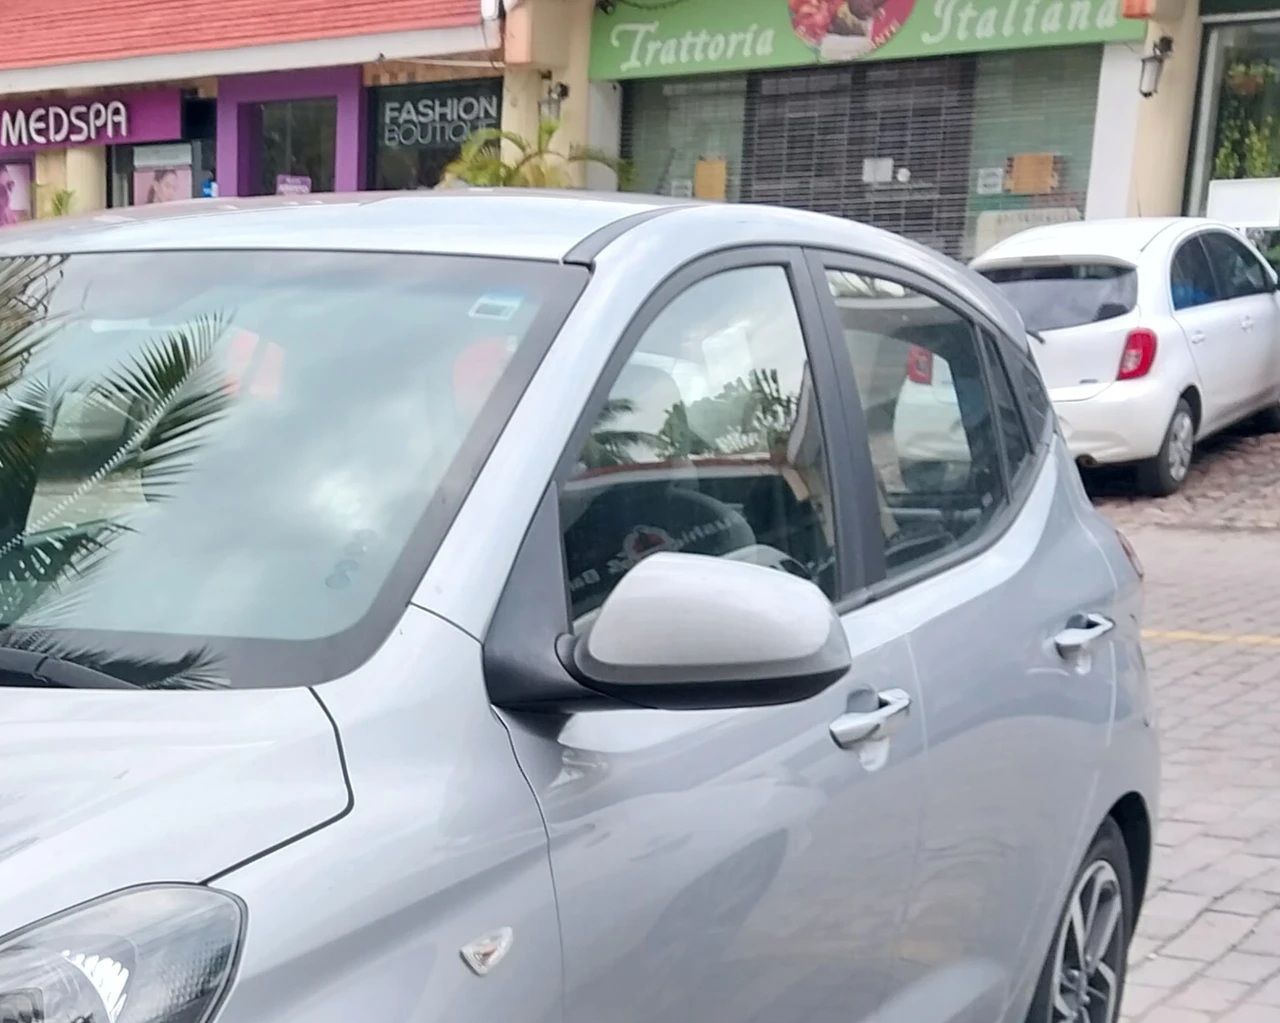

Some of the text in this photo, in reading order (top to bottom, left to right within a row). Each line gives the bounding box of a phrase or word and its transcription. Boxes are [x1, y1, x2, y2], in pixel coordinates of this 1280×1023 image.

[610, 20, 775, 71] Trattoria
[921, 0, 1118, 44] Italiana
[1, 100, 127, 147] MEDSPA
[384, 95, 497, 124] FASHION
